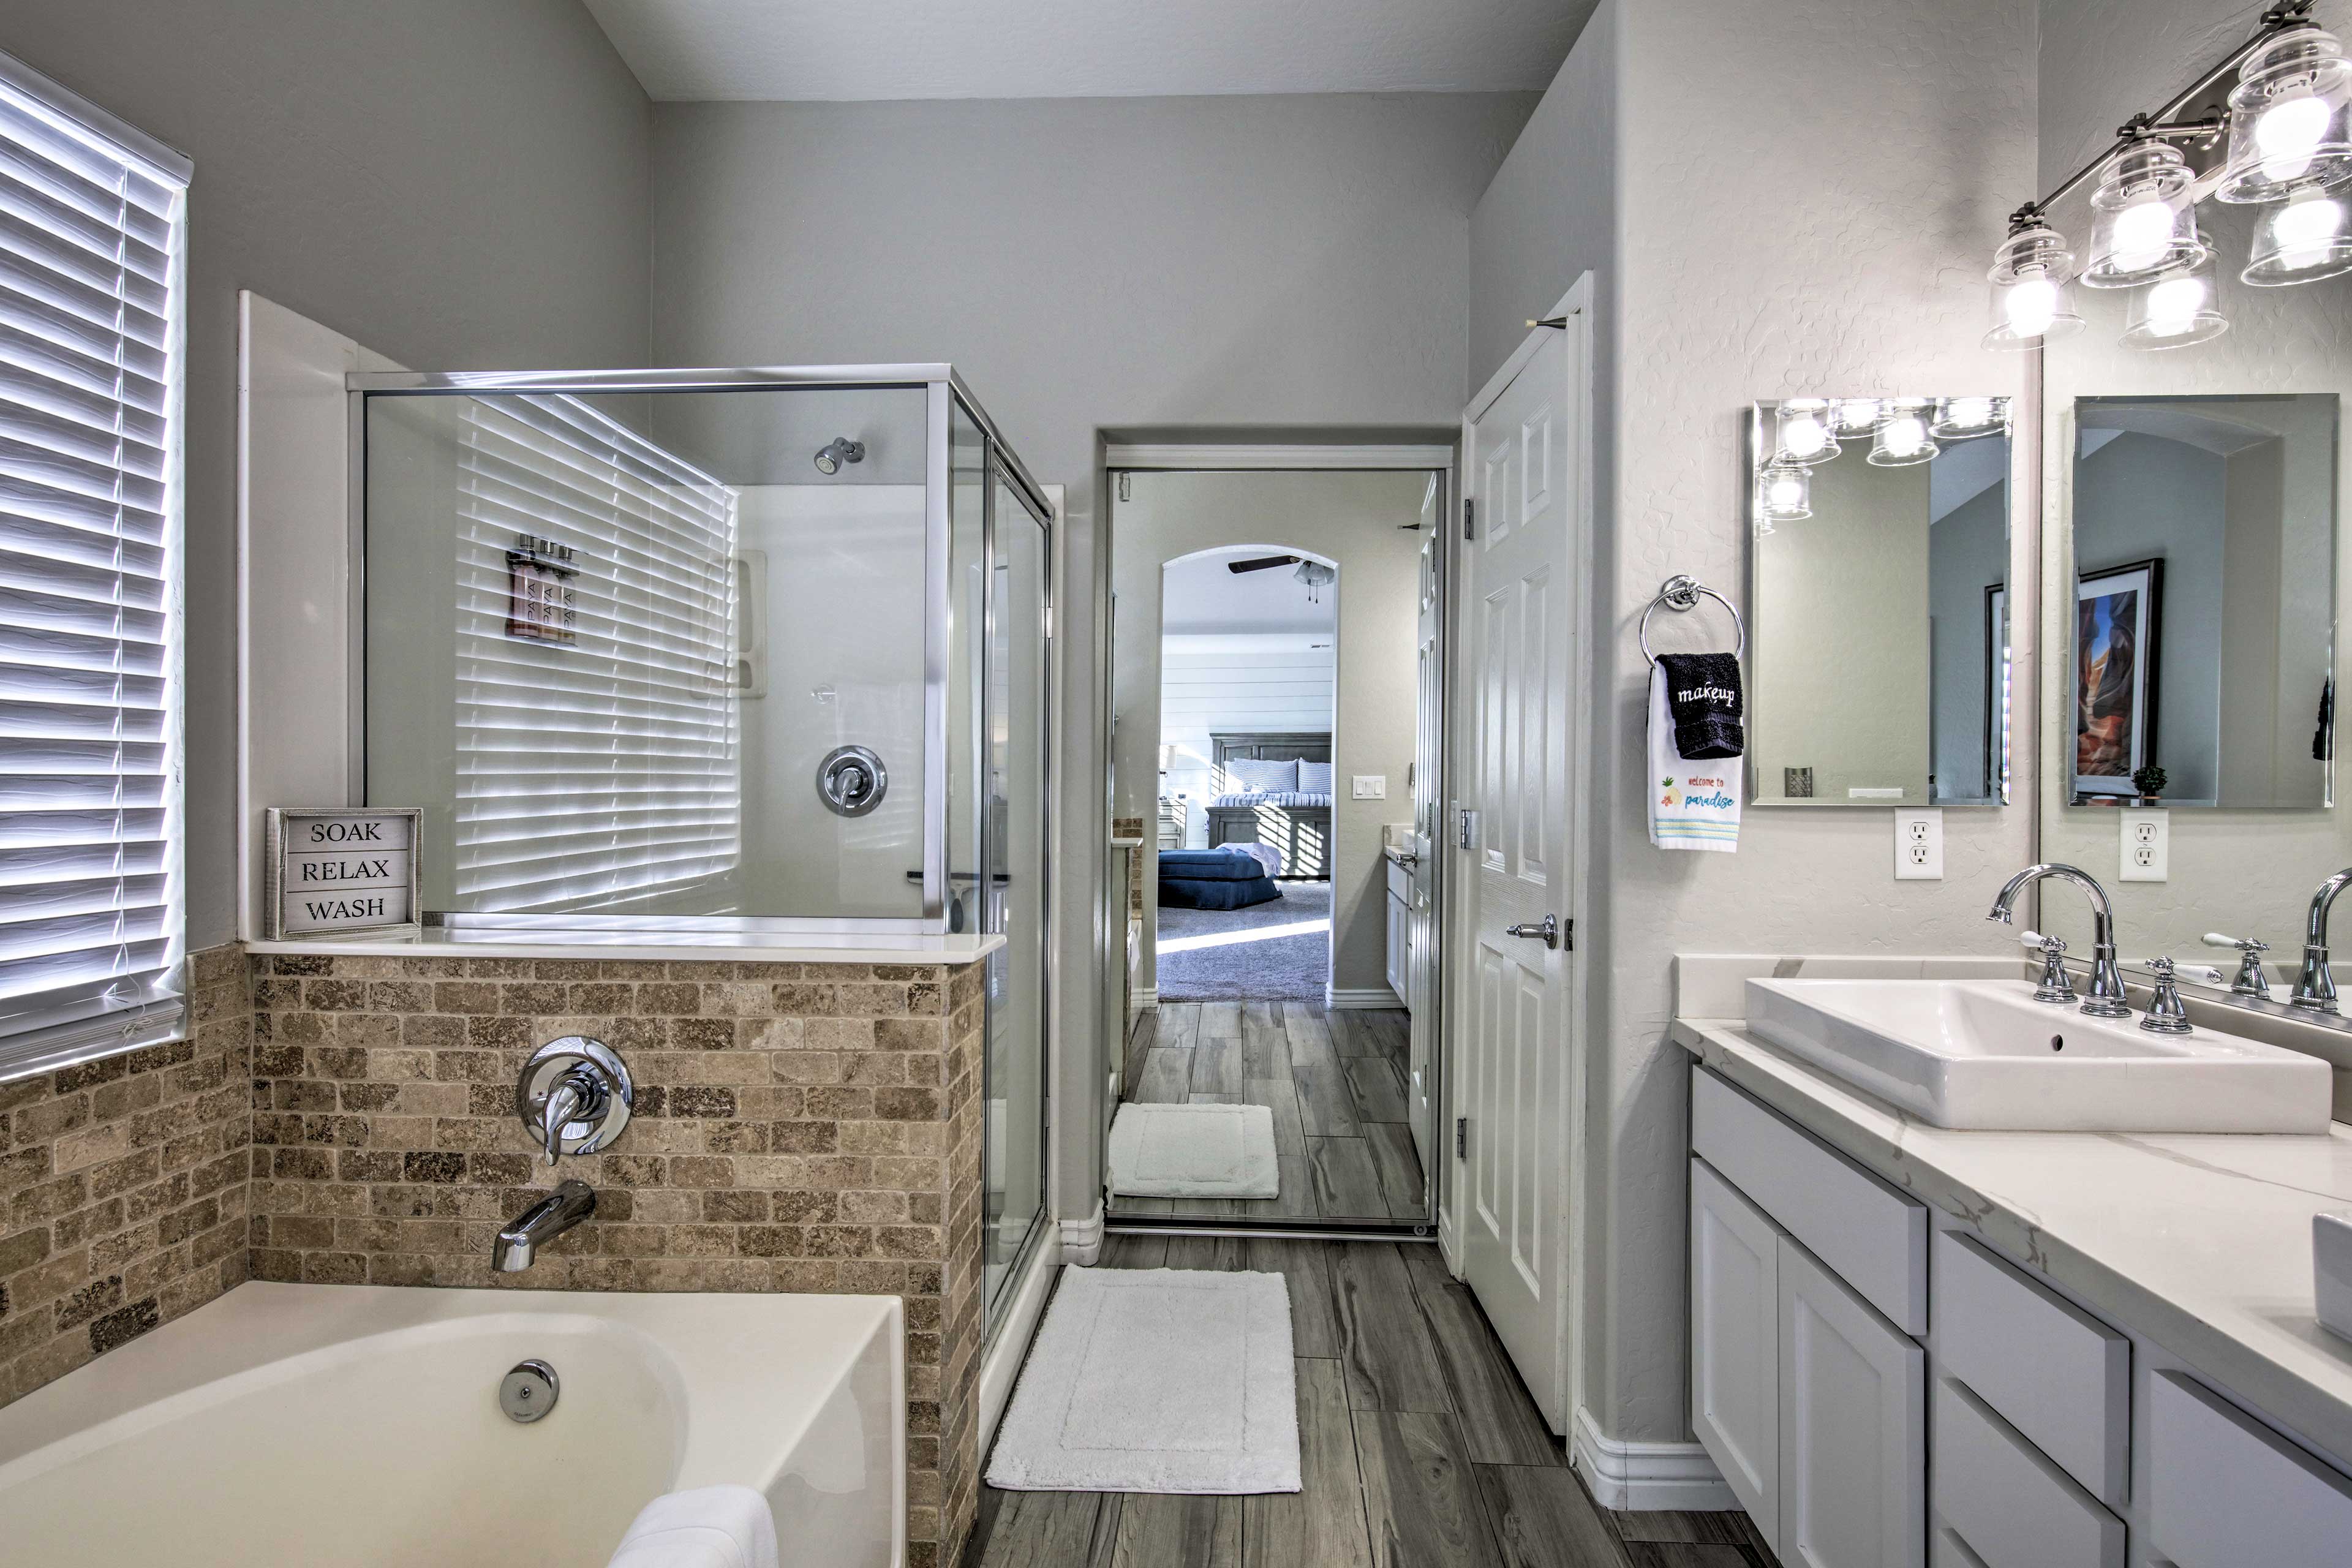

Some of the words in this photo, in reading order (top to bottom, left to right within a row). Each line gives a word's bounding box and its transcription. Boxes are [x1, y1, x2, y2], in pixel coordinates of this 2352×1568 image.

[543, 588, 552, 625] PAYA
[1678, 681, 1735, 707] makeup
[1689, 775, 1714, 787] welcome
[1717, 777, 1724, 788] to
[1685, 791, 1735, 809] paradise
[311, 823, 382, 842] SOAK
[302, 860, 390, 881] RELAX
[306, 898, 384, 920] WASH
